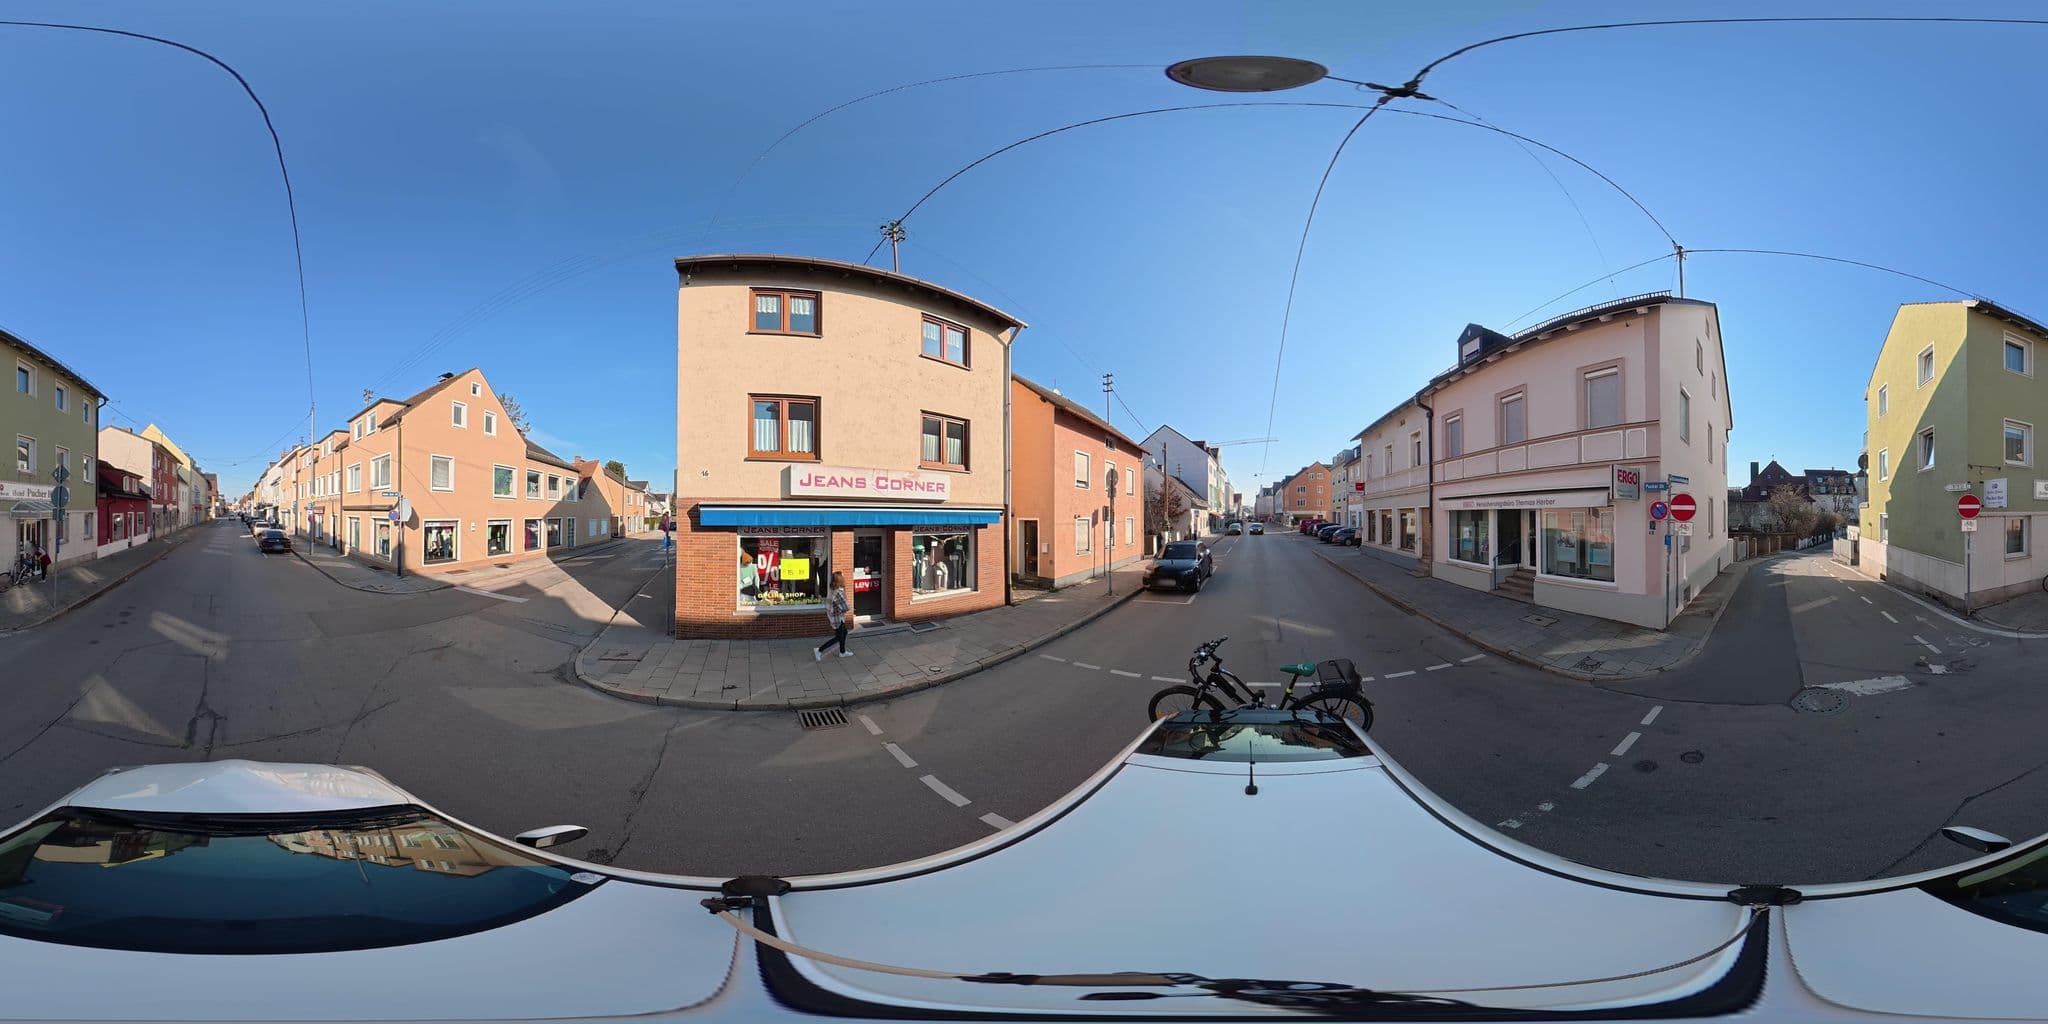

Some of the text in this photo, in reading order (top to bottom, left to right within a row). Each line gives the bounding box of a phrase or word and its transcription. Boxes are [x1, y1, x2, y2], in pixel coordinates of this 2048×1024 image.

[800, 473, 945, 493] JEANS CORNER
[1617, 469, 1638, 485] ERGO
